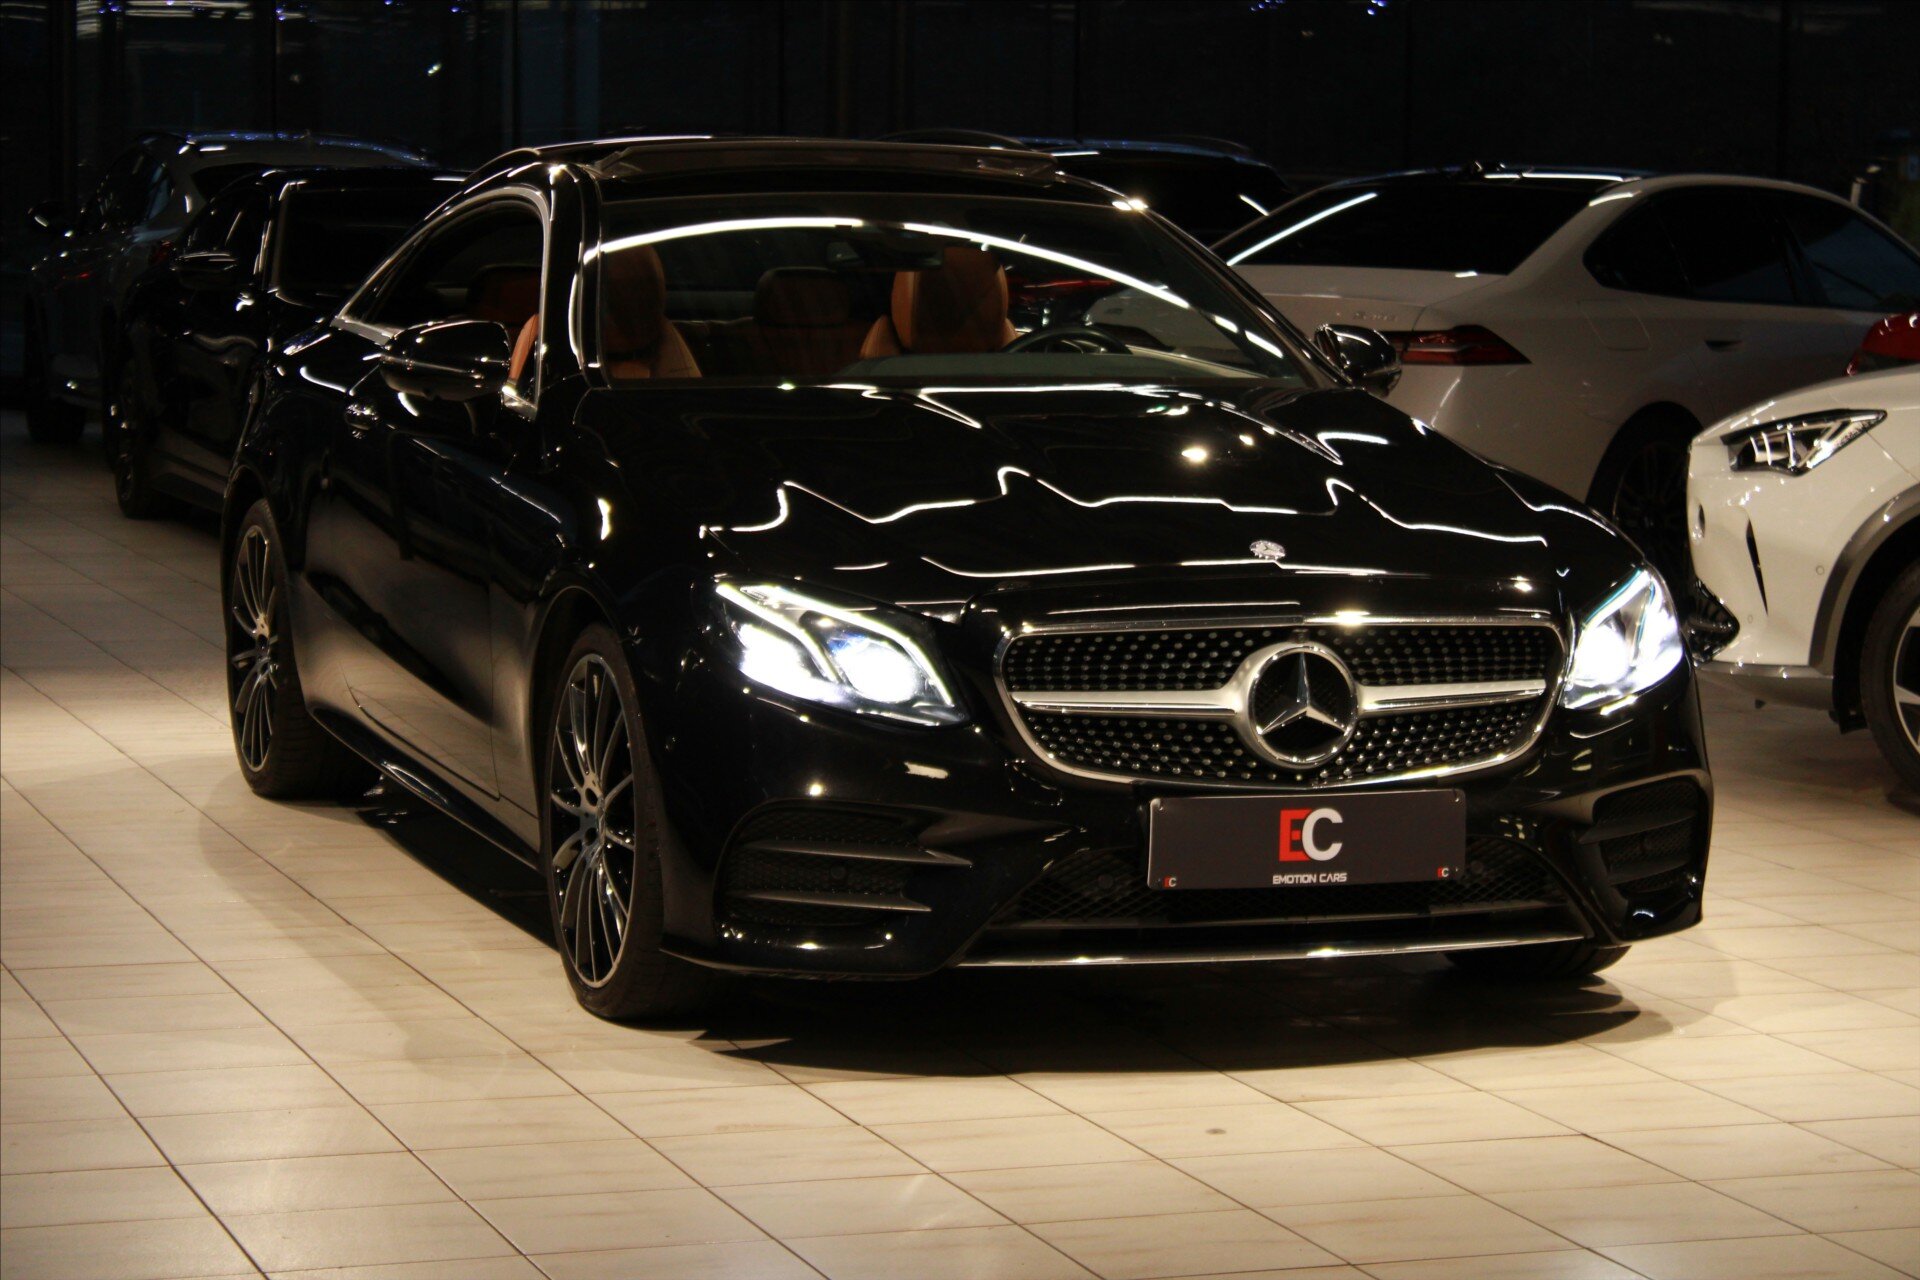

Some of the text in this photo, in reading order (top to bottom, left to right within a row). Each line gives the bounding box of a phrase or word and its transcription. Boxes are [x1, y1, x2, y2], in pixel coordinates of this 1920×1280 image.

[1279, 807, 1344, 862] EC
[1272, 872, 1348, 885] EMOTION CARS
